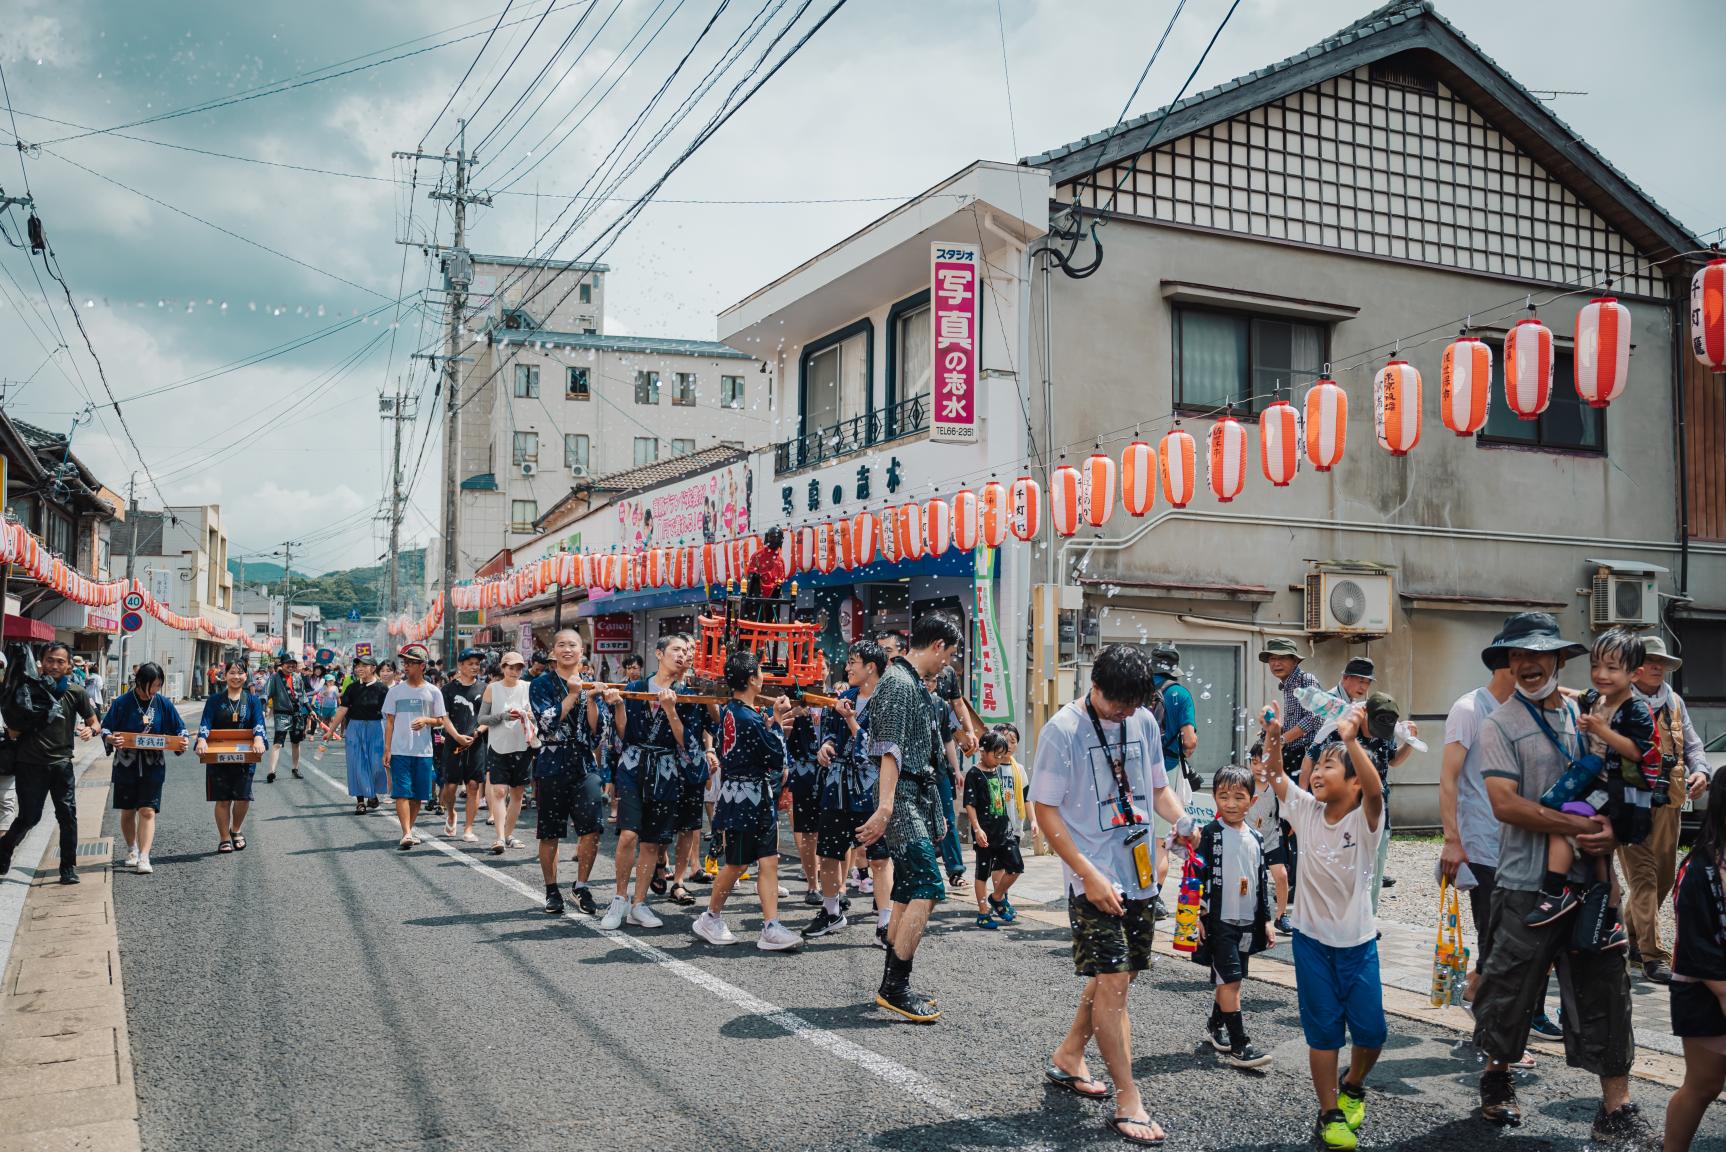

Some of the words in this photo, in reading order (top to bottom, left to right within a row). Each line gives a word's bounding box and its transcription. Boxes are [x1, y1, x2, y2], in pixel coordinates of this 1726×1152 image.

[936, 248, 974, 261] スタジオ
[937, 269, 973, 418] 写真の志水
[936, 426, 974, 437] TEL66-2351
[127, 597, 140, 606] 40
[357, 646, 371, 656] 江
